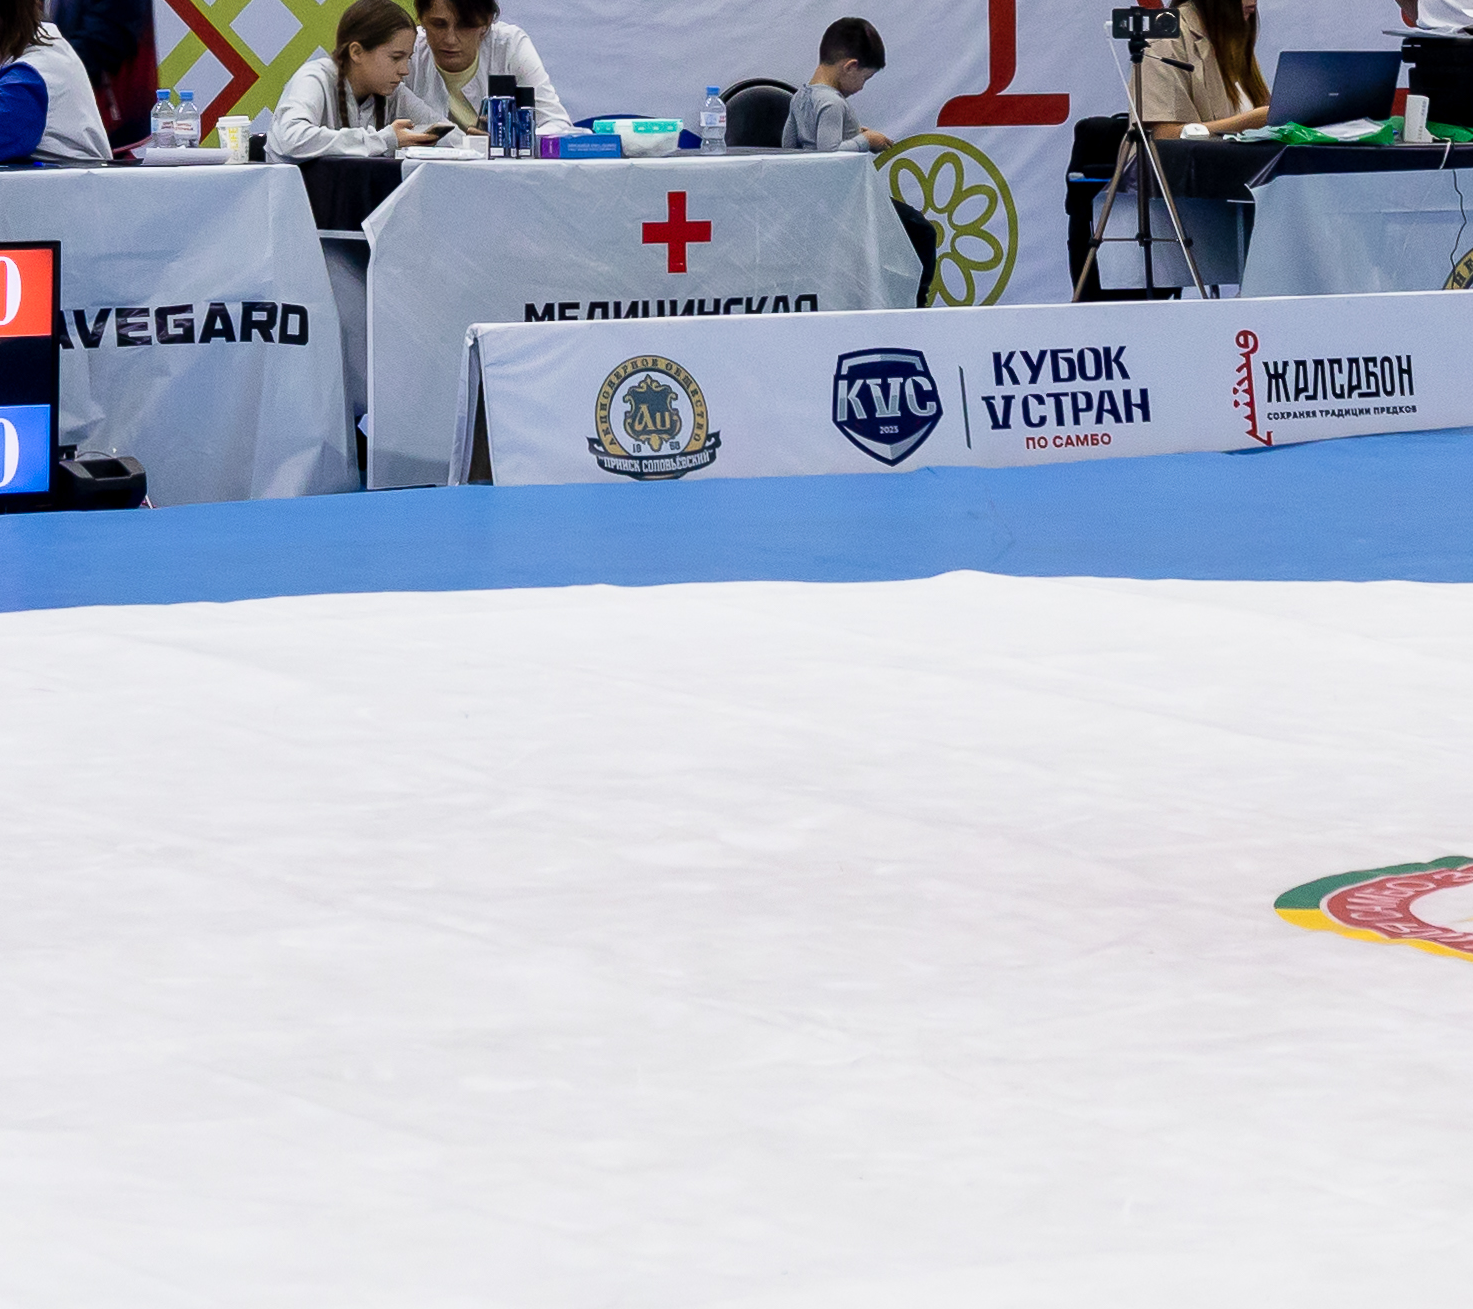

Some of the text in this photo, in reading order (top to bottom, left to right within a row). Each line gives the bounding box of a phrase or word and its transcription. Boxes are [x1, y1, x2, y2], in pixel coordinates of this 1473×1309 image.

[60, 301, 309, 349] VEGARD
[992, 346, 1131, 386] КУБОК
[1262, 354, 1415, 403] ЖАЛСАБОН
[837, 375, 938, 422] KVC
[1021, 388, 1151, 429] СТРАН
[1267, 404, 1417, 421] СОХРАНЯЯ ТРАДИЦИИ ПРЕДКОВ
[1025, 433, 1112, 449] ПО САМБО
[1350, 879, 1437, 921] САМБО
